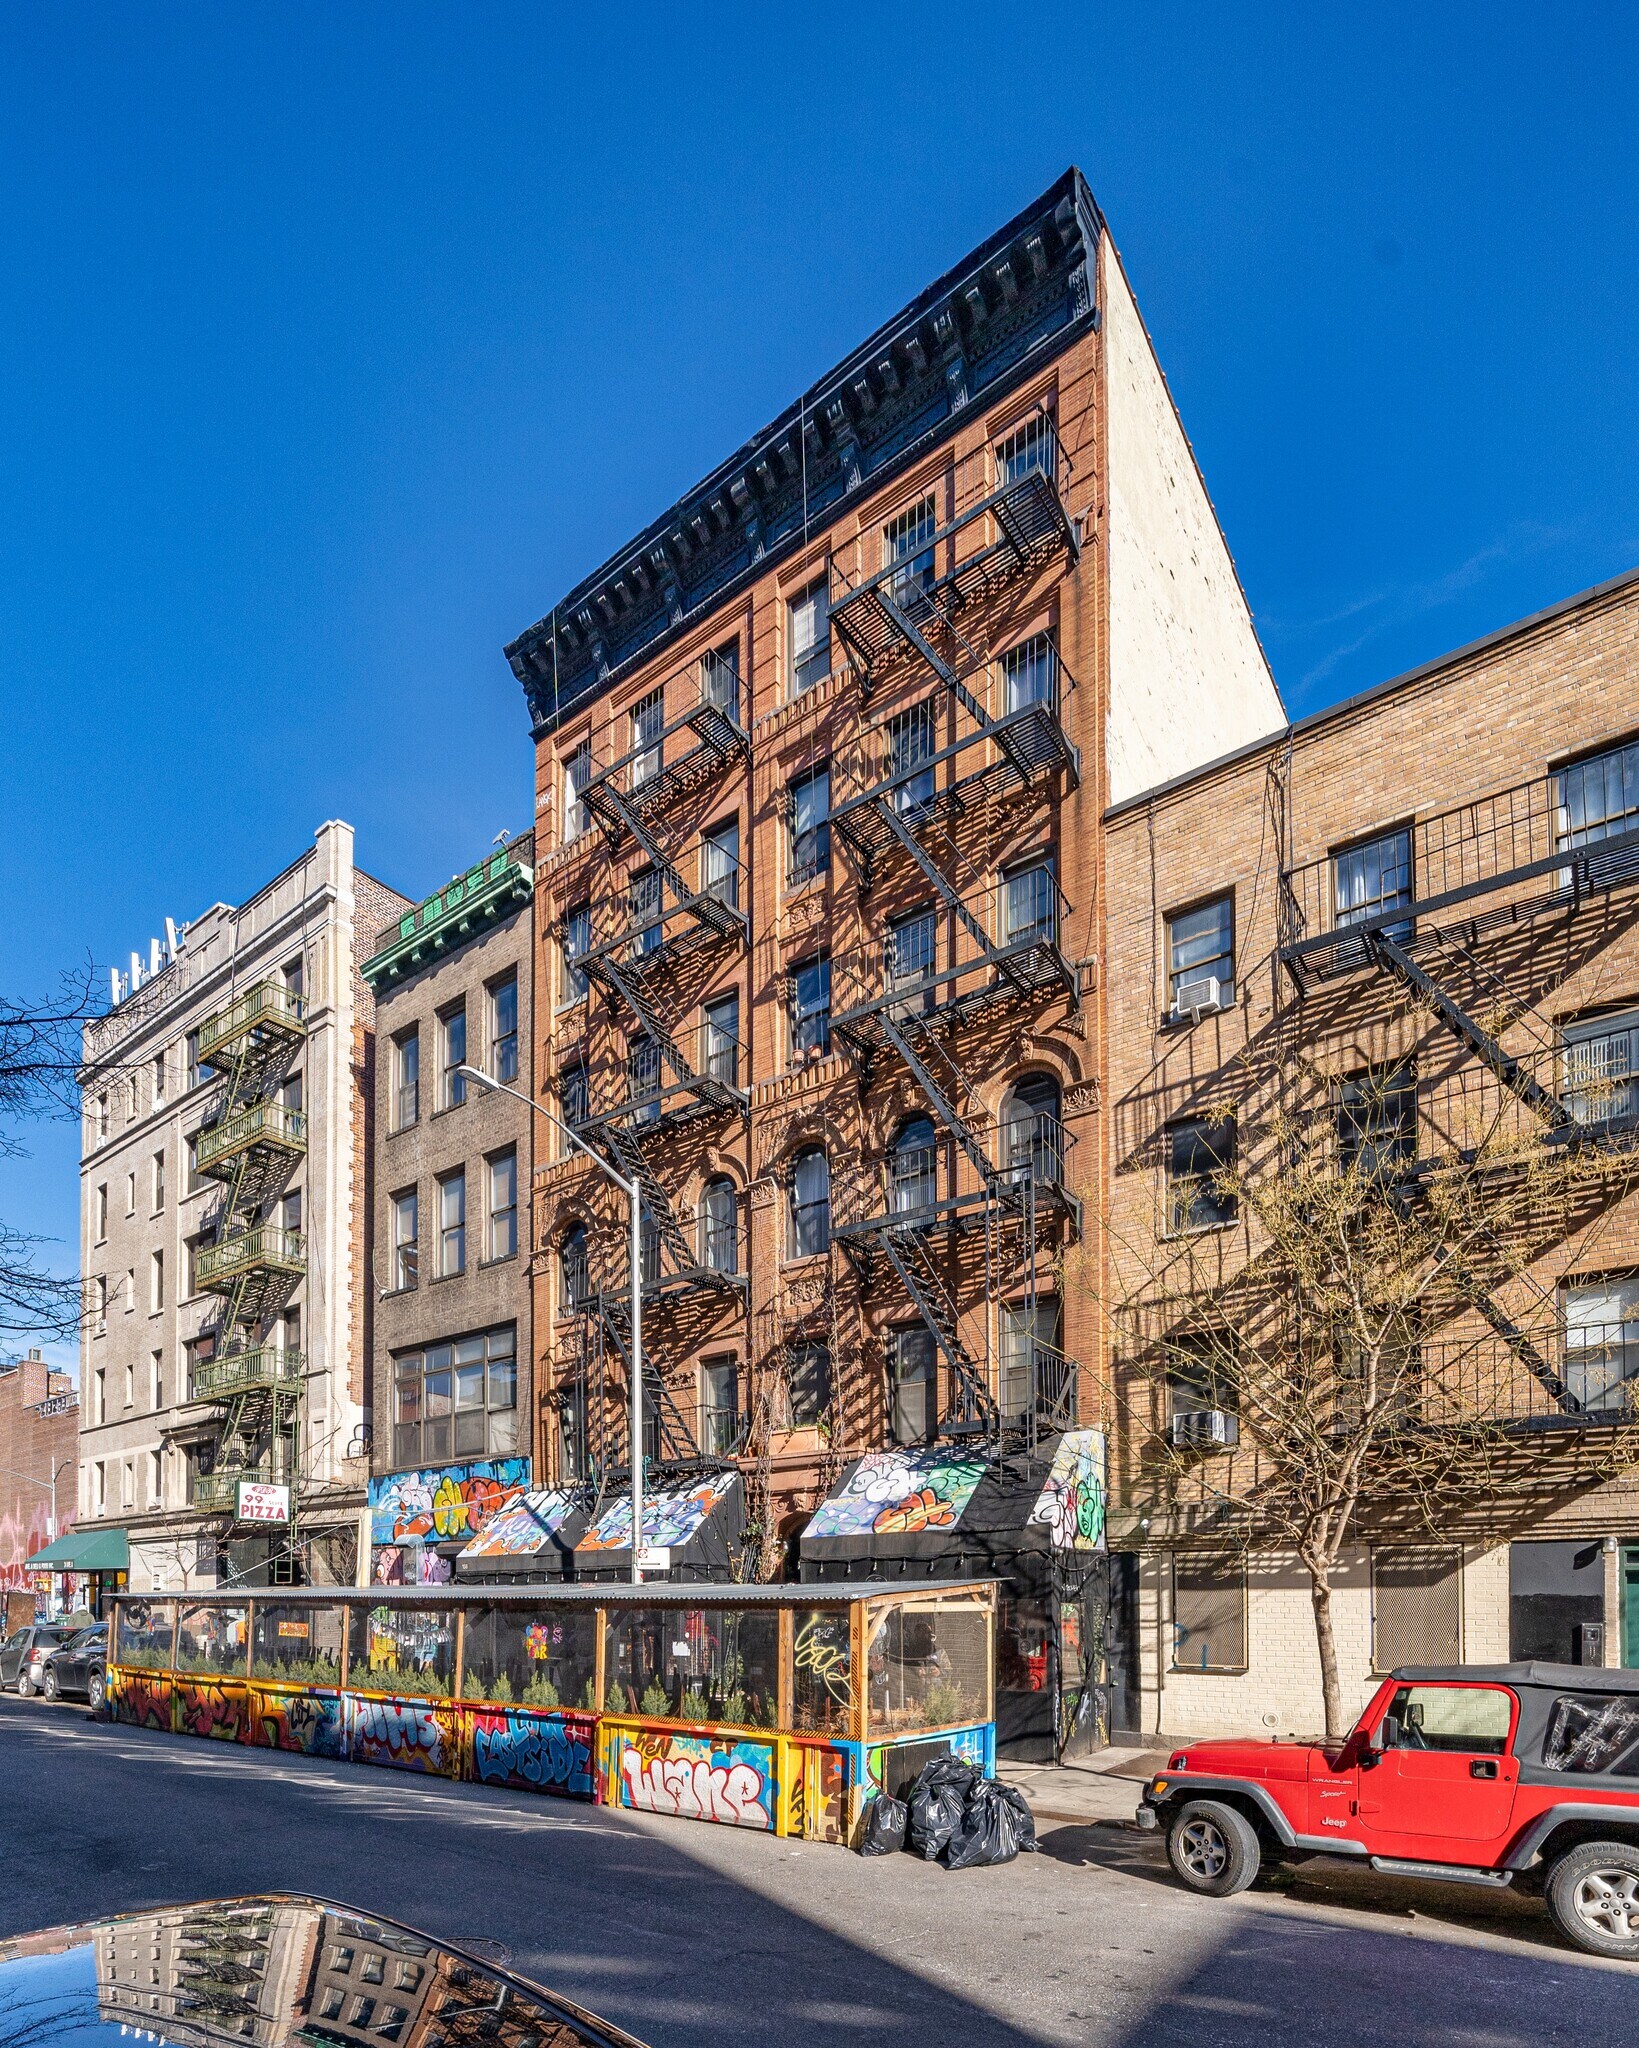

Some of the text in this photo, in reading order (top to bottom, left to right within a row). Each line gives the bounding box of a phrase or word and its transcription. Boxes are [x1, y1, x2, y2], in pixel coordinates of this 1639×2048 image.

[241, 1504, 286, 1520] PIZZA
[1312, 1777, 1353, 1785] WRANGLER
[1321, 1816, 1347, 1828] Jeep
